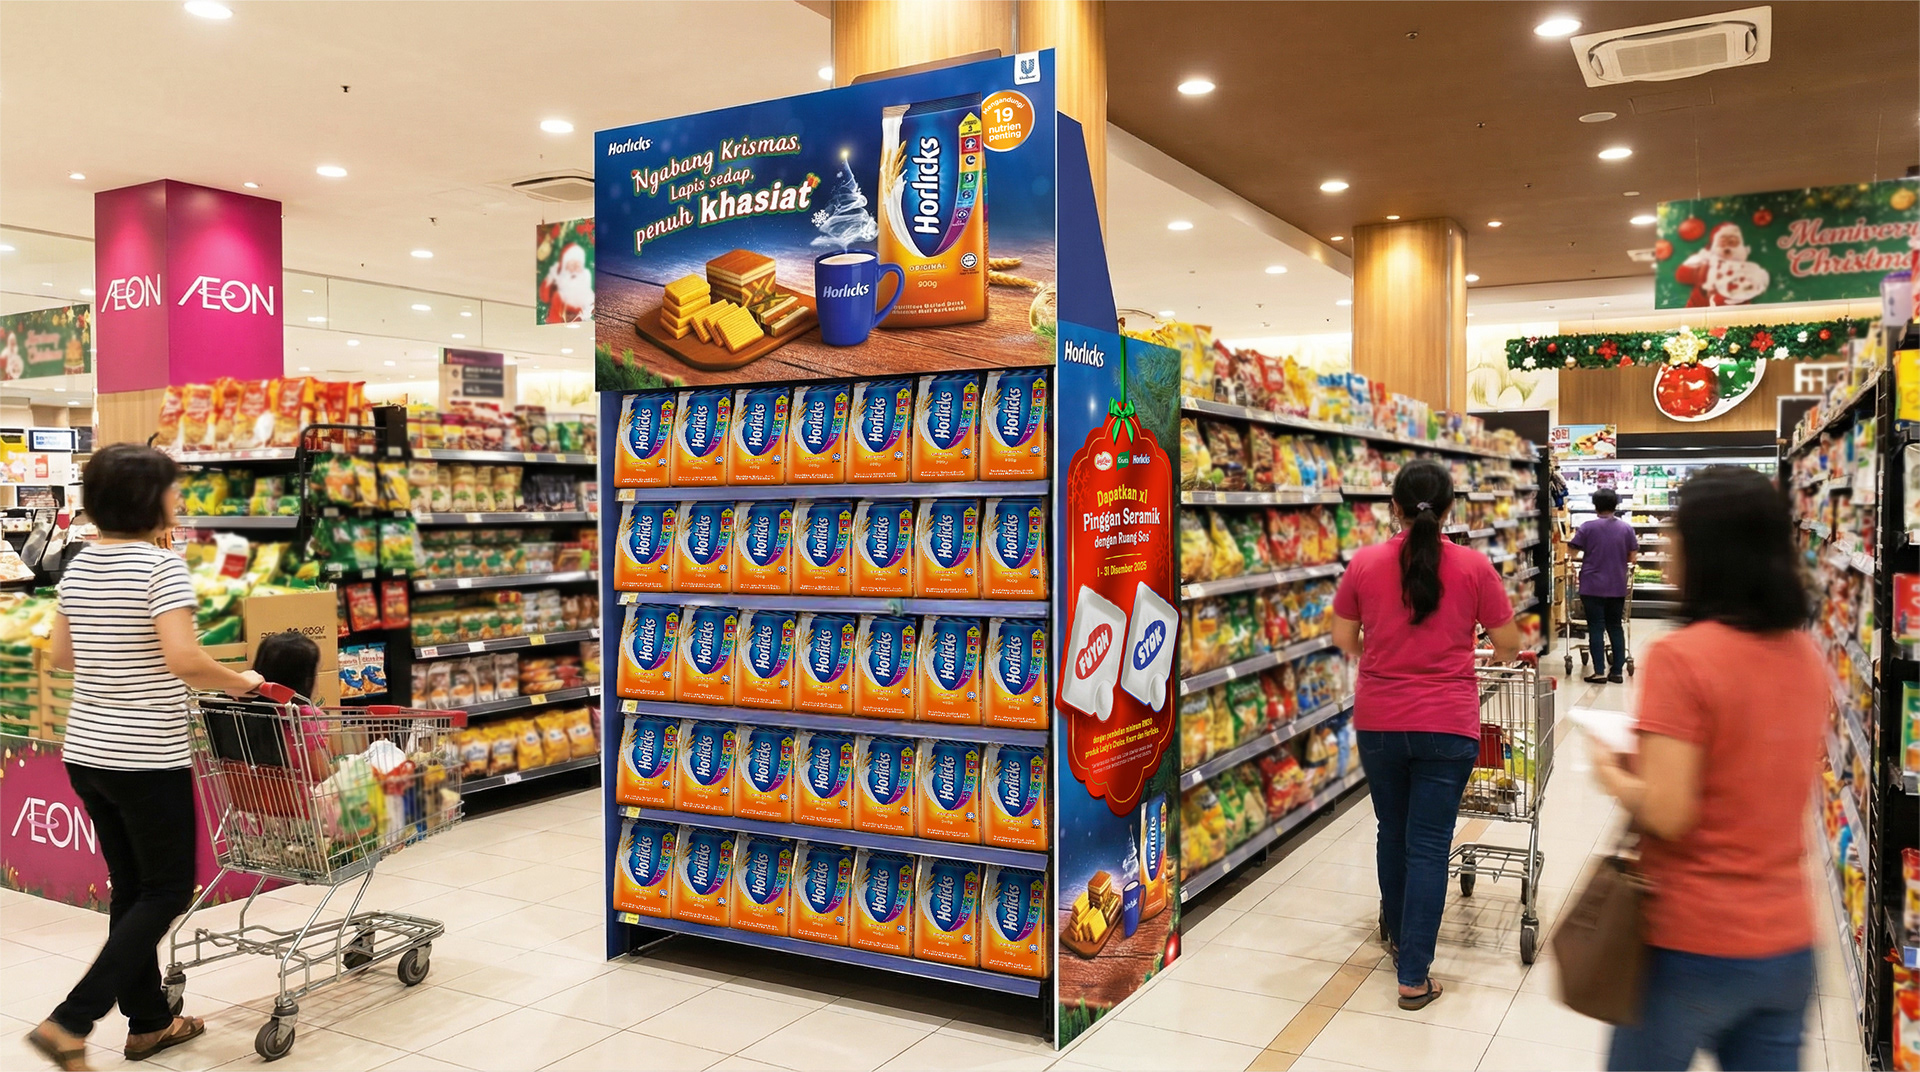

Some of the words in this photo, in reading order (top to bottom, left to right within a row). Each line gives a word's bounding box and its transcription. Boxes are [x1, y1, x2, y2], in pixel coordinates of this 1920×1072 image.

[982, 96, 1025, 115] Mengandungi
[993, 107, 1014, 124] 19
[607, 136, 652, 157] Horlicks
[988, 122, 1022, 135] nutrien
[988, 130, 1022, 143] penting
[632, 152, 714, 195] Ngabang
[670, 178, 705, 201] Lapis
[709, 167, 755, 188] sedap,
[912, 136, 941, 235] Horlicks
[636, 206, 694, 252] penuh
[700, 180, 812, 225] khasiat
[822, 282, 870, 299] Horlicks
[1064, 340, 1104, 368] Horlicks
[635, 407, 651, 450] Horlicks
[691, 405, 708, 448] Horlicks
[749, 403, 766, 447] Horlicks
[808, 400, 826, 445] Horlicks
[868, 397, 887, 443] Horlicks
[934, 391, 952, 439] Horlicks
[1003, 387, 1022, 437] Horlicks
[1097, 484, 1138, 507] Dapatkan
[636, 515, 653, 556] Horlicks
[694, 515, 711, 556] Horlicks
[753, 516, 770, 557] Horlicks
[813, 517, 829, 559] Horlicks
[873, 515, 890, 559] Horlicks
[937, 514, 954, 559] Horlicks
[1003, 513, 1018, 559] Horlicks
[1083, 511, 1121, 533] Pinggan
[1123, 507, 1161, 525] Seramik
[1094, 532, 1117, 549] dengan
[1118, 530, 1137, 546] Ruang
[1110, 564, 1133, 576] Disember
[1134, 561, 1147, 572] 2025
[639, 618, 656, 661] Horlicks
[697, 621, 714, 665] Horlicks
[756, 625, 773, 669] Horlicks
[815, 629, 832, 674] Horlicks
[876, 632, 893, 678] Horlicks
[939, 633, 956, 681] Horlicks
[1006, 635, 1022, 685] Horlicks
[1078, 629, 1109, 677] FUYOH
[1137, 625, 1163, 666] SYOK
[638, 729, 655, 770] Horlicks
[696, 735, 713, 777] Horlicks
[755, 741, 771, 784] Horlicks
[815, 747, 831, 790] Horlicks
[875, 752, 890, 796] Horlicks
[939, 755, 955, 801] Horlicks
[1005, 760, 1021, 807] Horlicks
[635, 836, 653, 878] Horlicks
[693, 843, 711, 886] Horlicks
[752, 852, 770, 896] Horlicks
[812, 861, 829, 905] Horlicks
[872, 869, 889, 914] Horlicks
[937, 875, 955, 922] Horlicks
[1003, 883, 1021, 932] Horlicks
